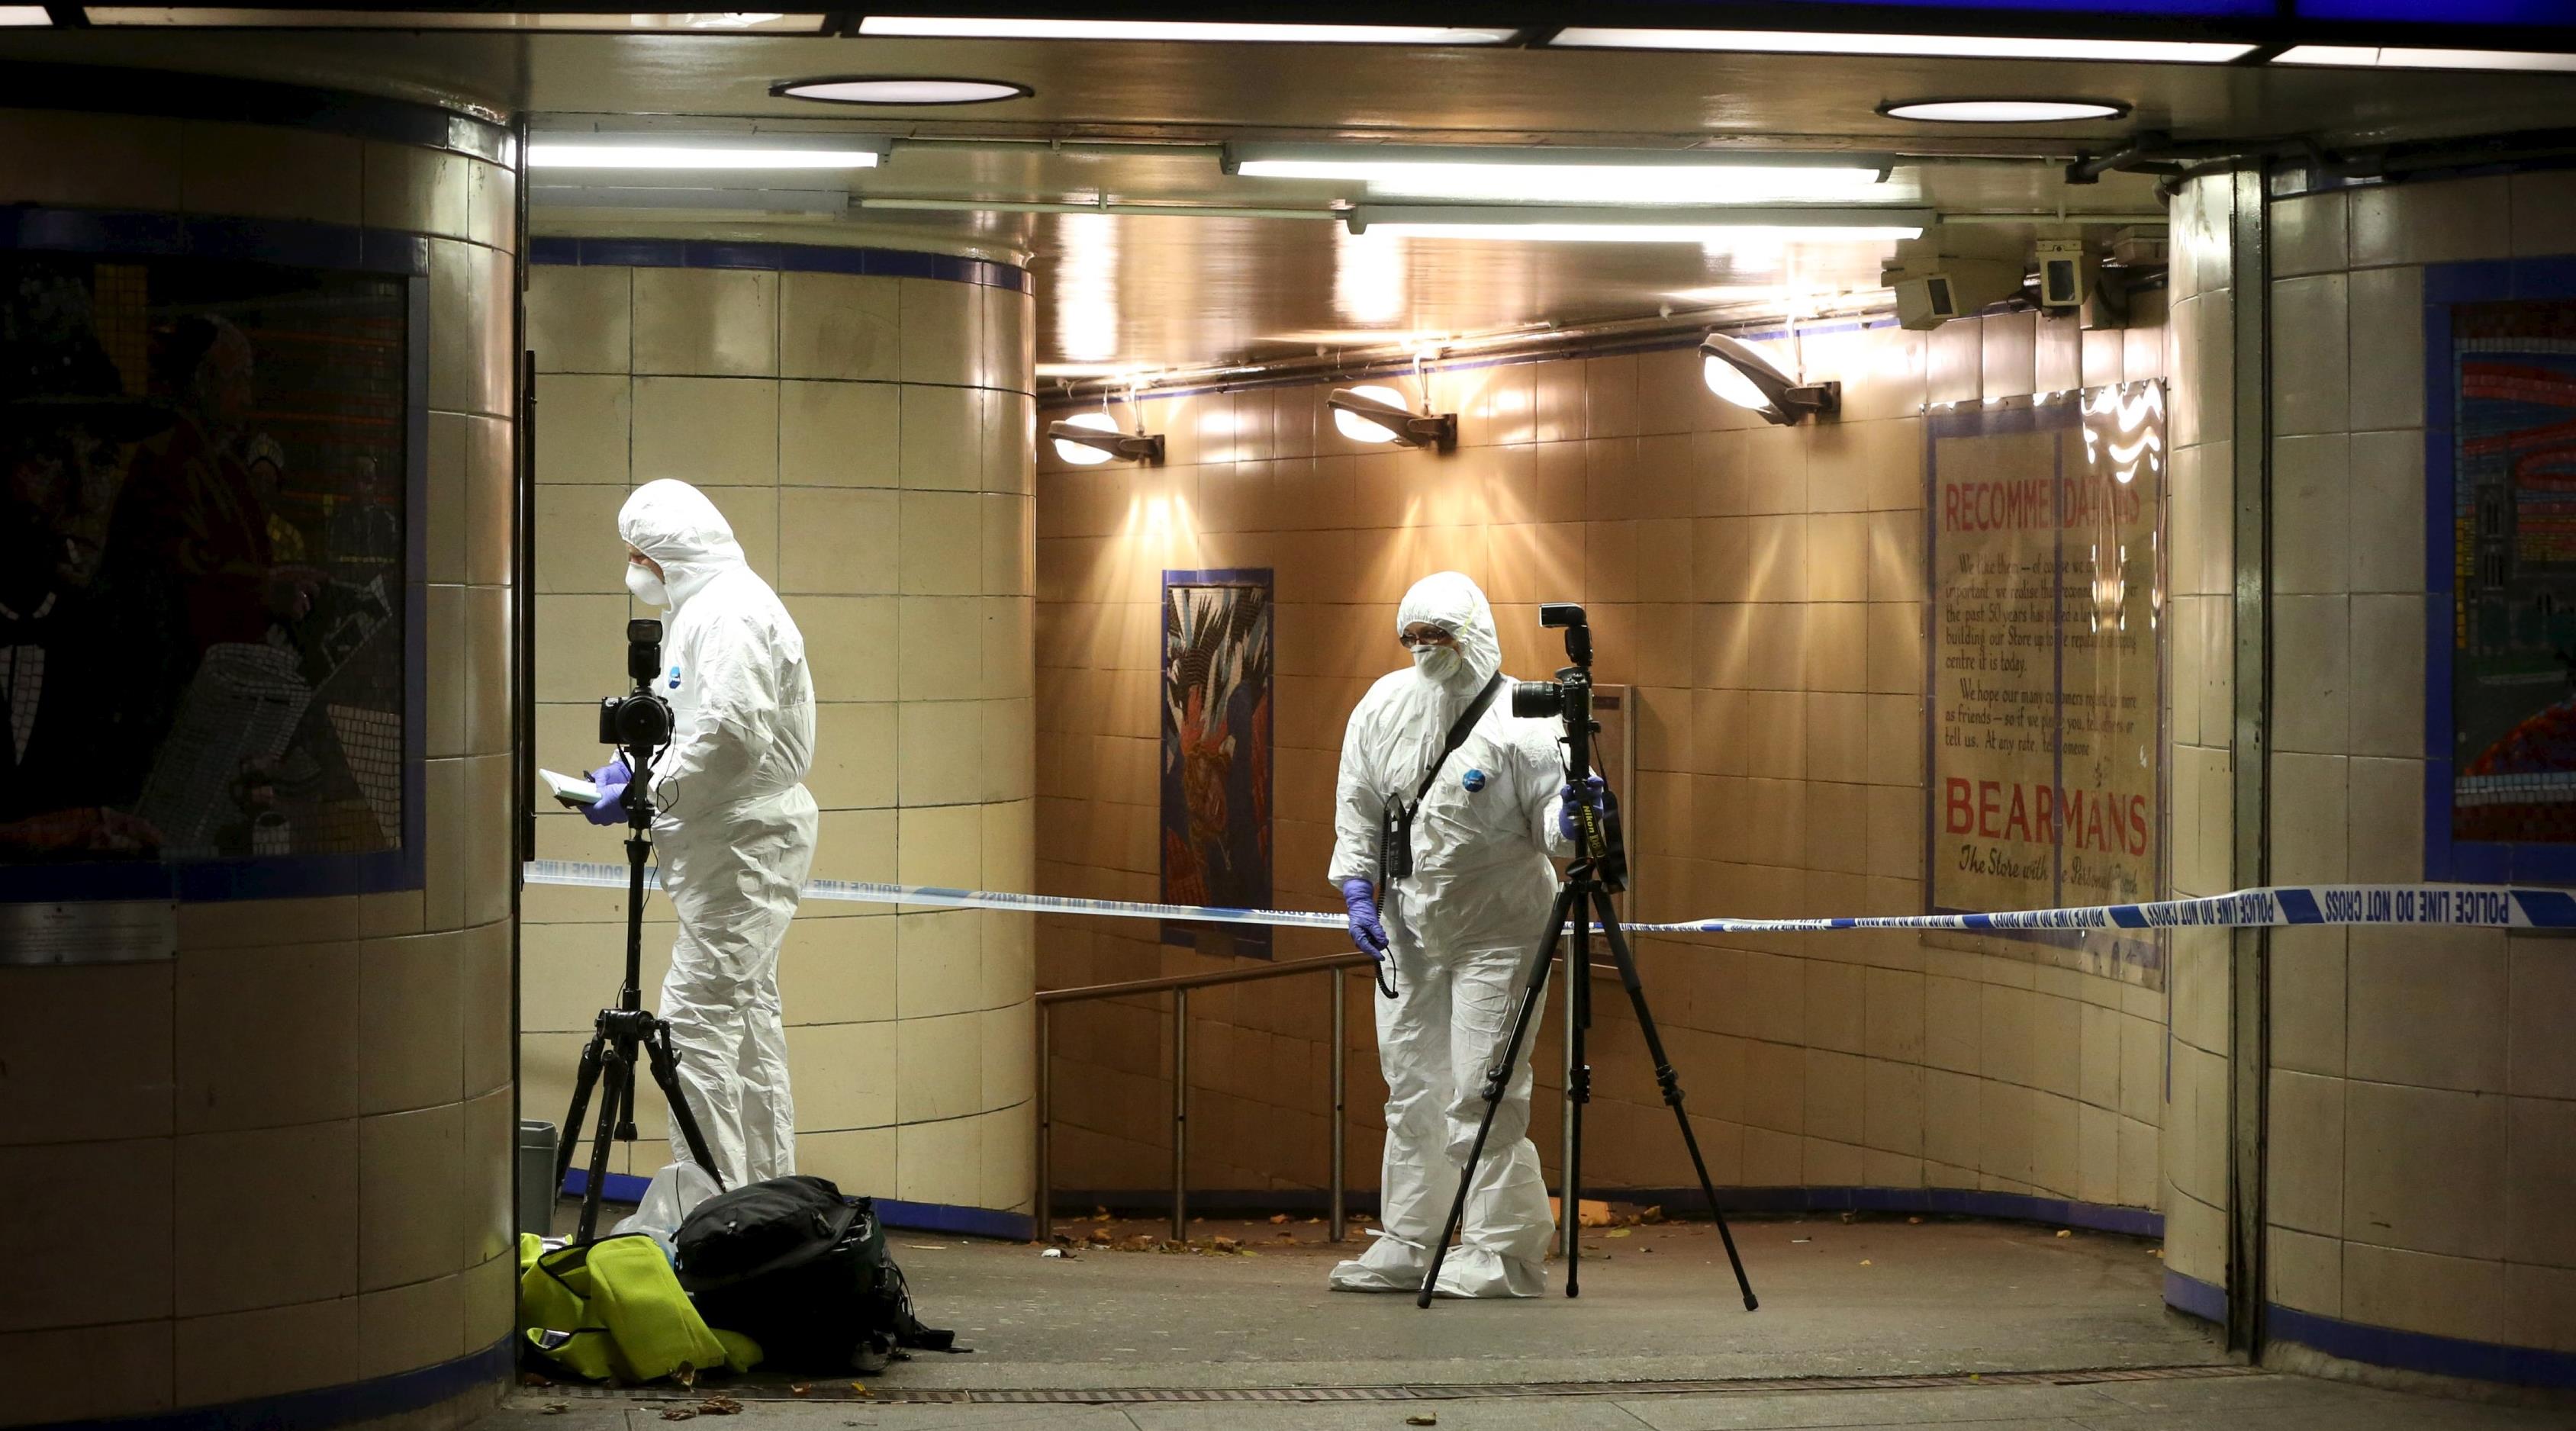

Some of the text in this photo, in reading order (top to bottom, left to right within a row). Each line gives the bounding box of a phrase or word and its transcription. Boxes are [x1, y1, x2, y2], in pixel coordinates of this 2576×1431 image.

[1946, 603, 1961, 623] the
[1966, 604, 1984, 627] past
[2003, 609, 2027, 627] years
[1946, 625, 1985, 654] building
[1989, 633, 2005, 646] our
[2008, 625, 2031, 646] Store
[1946, 648, 2027, 678] centre it is today.
[1959, 677, 1975, 701] We
[1977, 678, 1999, 709] hope
[2002, 689, 2019, 703] our
[2021, 690, 2043, 709] many
[1945, 710, 1956, 722] as
[1958, 703, 1991, 725] friends
[2004, 714, 2014, 726] so
[1945, 726, 1961, 746] tell
[1964, 735, 1979, 748] us.
[1985, 728, 1996, 749] At
[1998, 738, 2014, 756] any
[1582, 805, 1596, 834] Nikon
[1946, 777, 2147, 857] BEARMANS
[1959, 844, 1985, 873] The
[1988, 847, 2019, 878] Store
[2023, 854, 2049, 882] with
[2146, 892, 2274, 928] POLICE LINE DO NOT CROSS
[2325, 890, 2510, 925] POLICE LINE DO NOT CROSS
